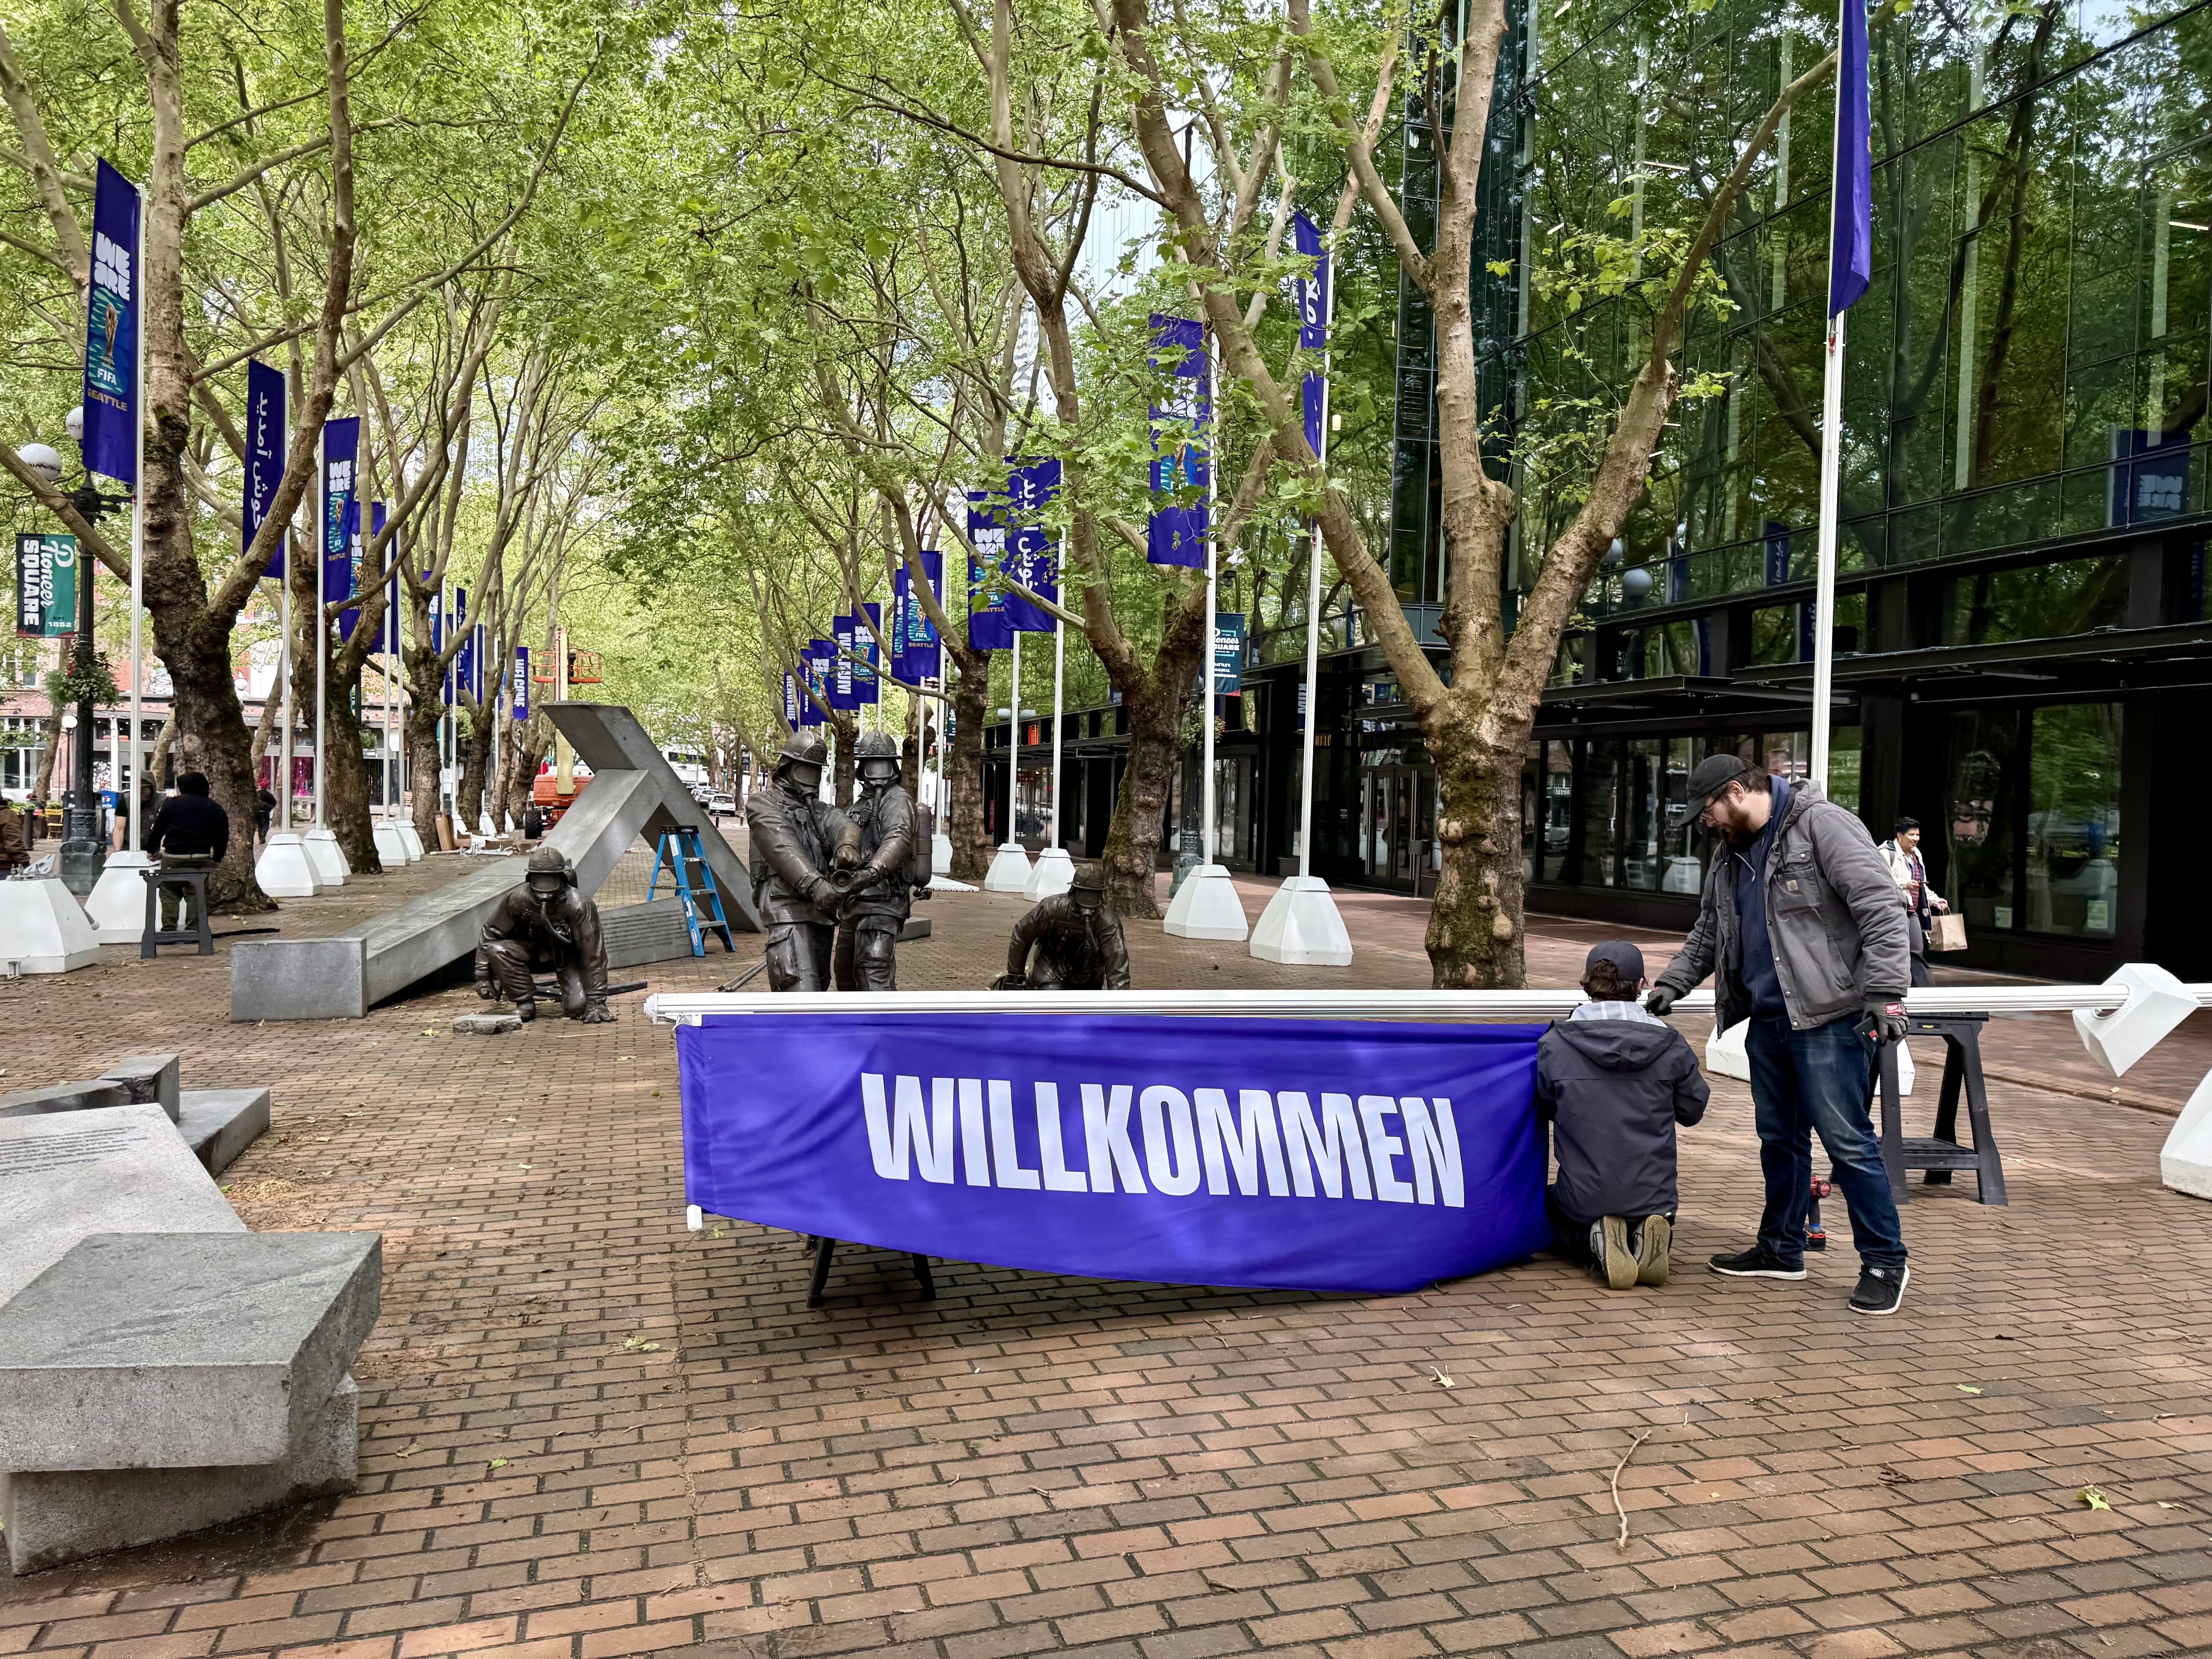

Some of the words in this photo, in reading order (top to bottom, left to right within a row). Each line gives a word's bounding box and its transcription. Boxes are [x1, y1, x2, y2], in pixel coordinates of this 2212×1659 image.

[96, 231, 130, 280] WE
[97, 368, 117, 385] FIFA
[329, 460, 351, 479] WE
[251, 461, 268, 529] خوش
[975, 529, 1005, 543] WE
[21, 539, 40, 626] SQUARE
[40, 540, 74, 608] Pioneer
[812, 658, 829, 666] WE
[861, 1072, 1465, 1208] WILLKOMMEN
